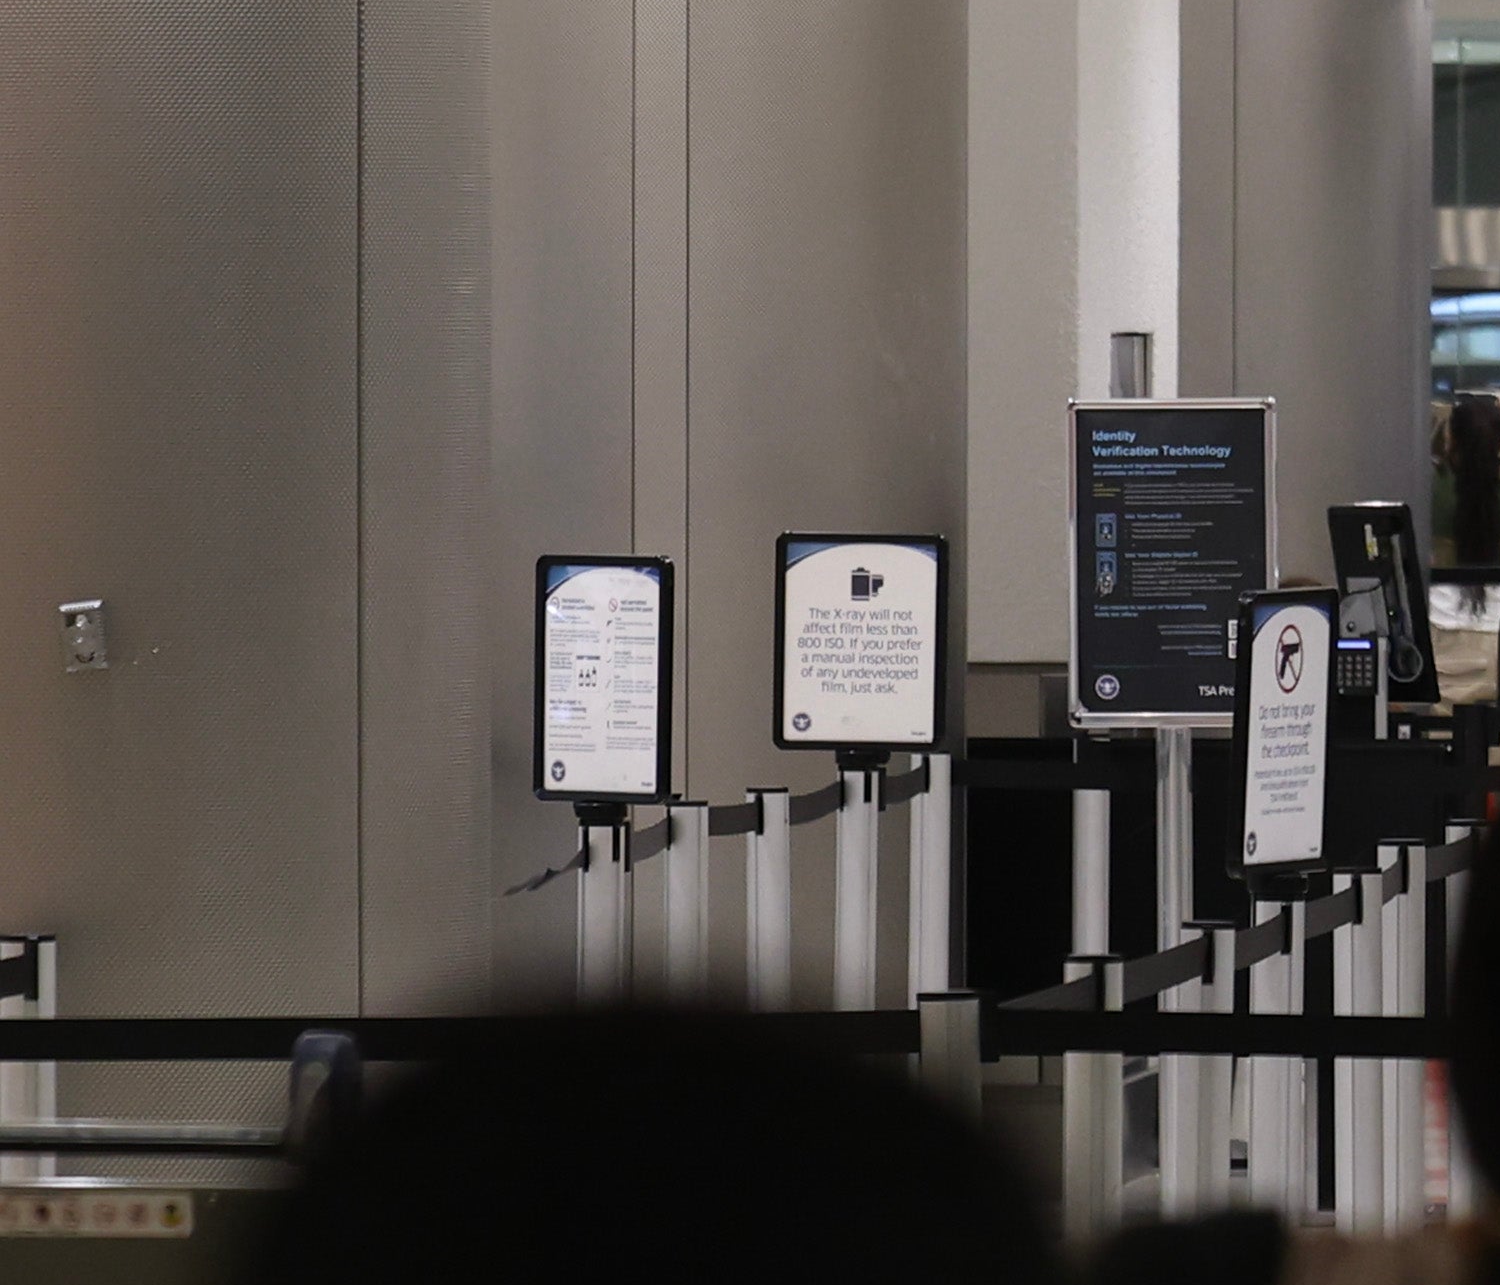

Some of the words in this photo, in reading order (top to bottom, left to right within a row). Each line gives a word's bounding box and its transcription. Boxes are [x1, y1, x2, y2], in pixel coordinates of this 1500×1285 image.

[1092, 430, 1136, 444] Identity
[1092, 446, 1159, 457] Verification
[1161, 445, 1232, 459] Technology
[809, 608, 830, 620] The
[833, 608, 866, 622] X-ray
[869, 609, 890, 620] will
[893, 610, 912, 621] not
[803, 623, 837, 635] affect
[839, 623, 863, 635] film
[866, 623, 888, 635] less
[891, 624, 918, 635] than
[797, 637, 821, 649] 800
[850, 637, 858, 649] If
[861, 640, 884, 651] you
[886, 638, 922, 652] prefer
[801, 655, 808, 664] a
[811, 653, 856, 664] manual
[858, 653, 919, 666] inspection
[801, 666, 814, 678] of
[816, 668, 839, 680] any
[842, 667, 919, 681] undeveloped
[850, 682, 871, 695] just
[874, 682, 898, 694] ask.
[1198, 685, 1217, 696] TSA
